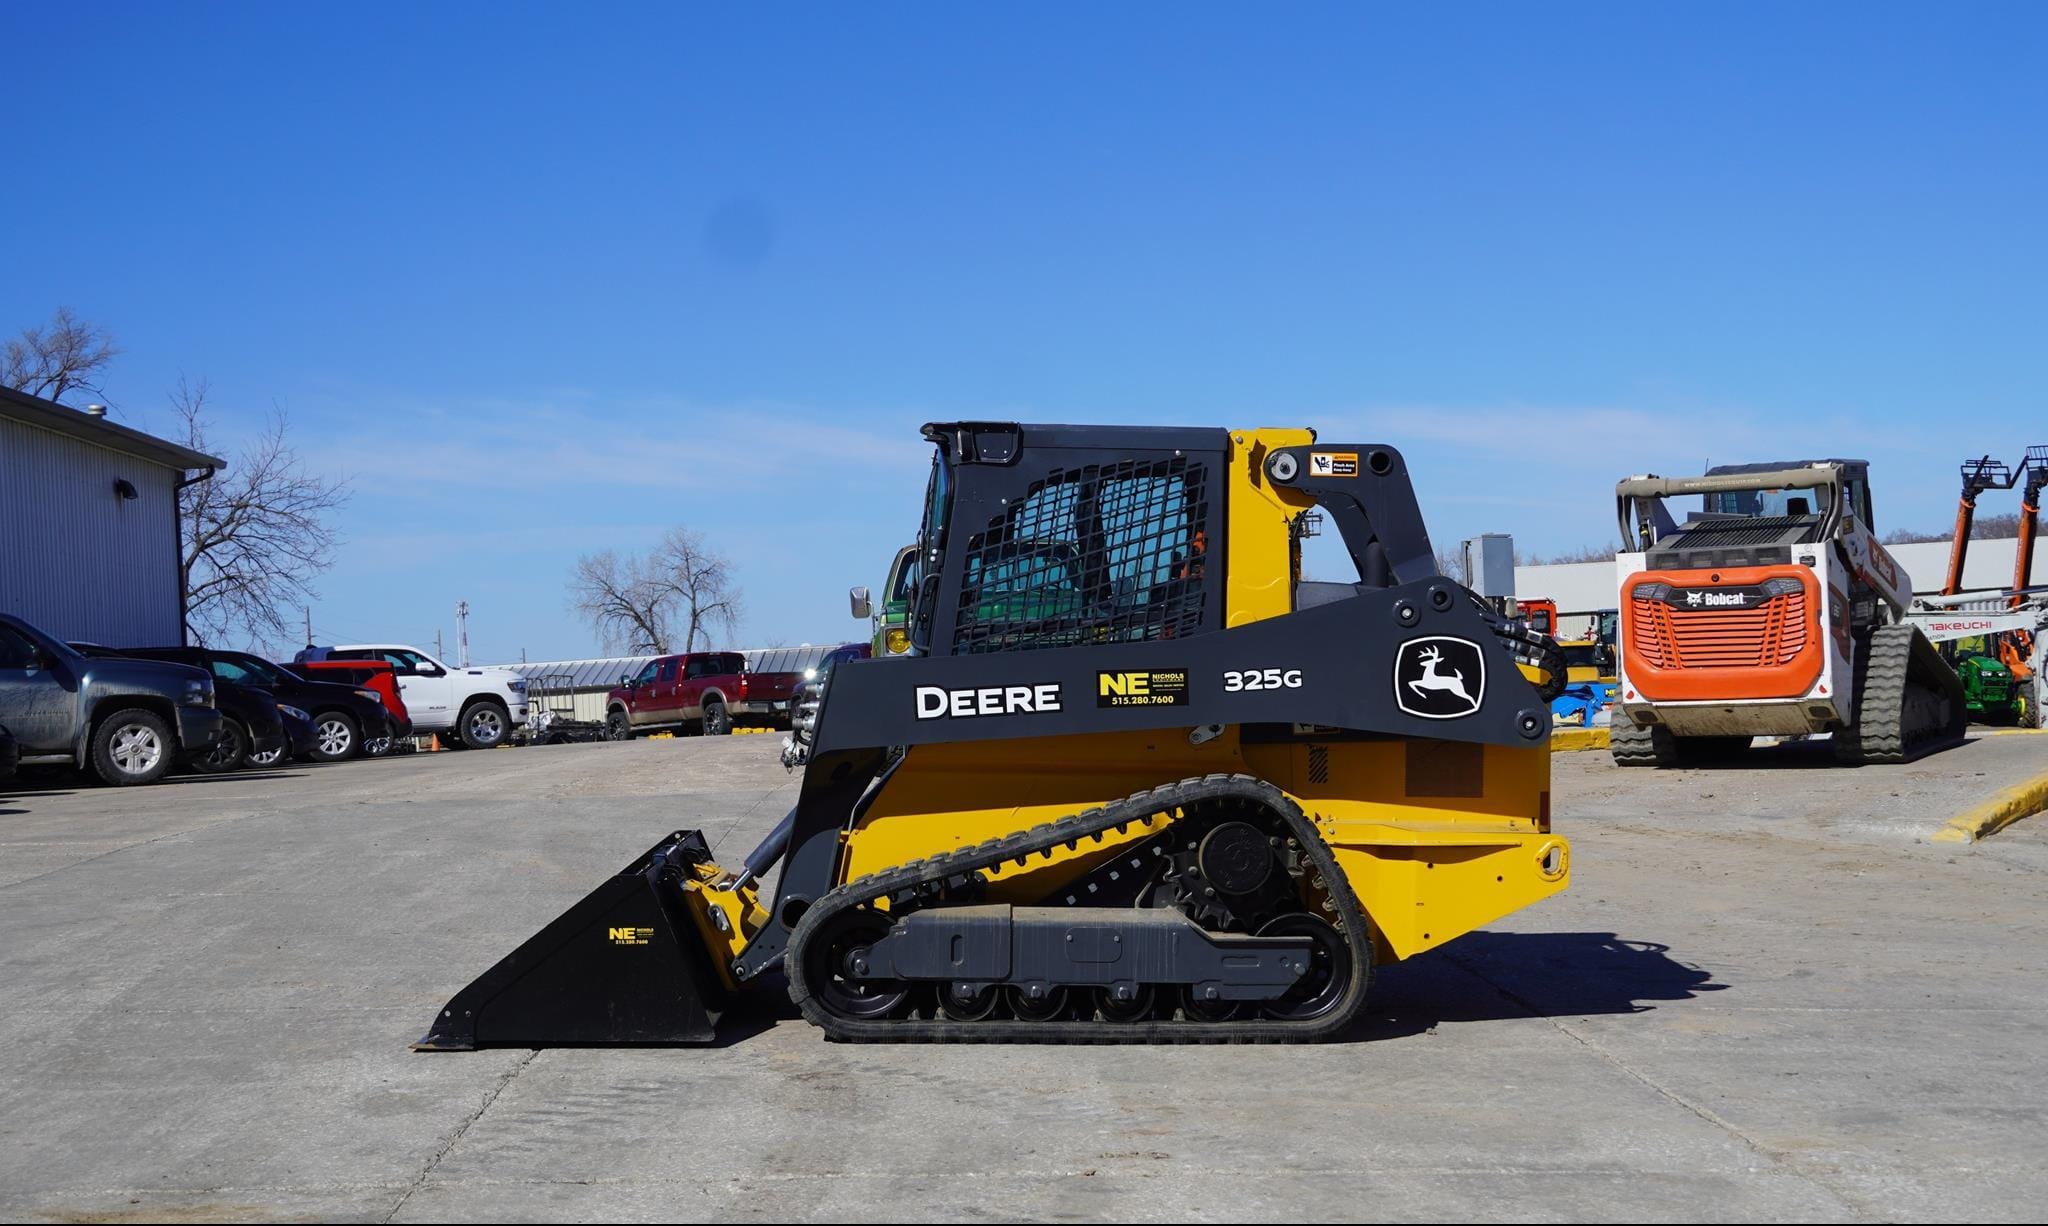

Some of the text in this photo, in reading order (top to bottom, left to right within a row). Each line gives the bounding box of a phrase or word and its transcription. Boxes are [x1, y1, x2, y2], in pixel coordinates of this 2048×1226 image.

[1705, 592, 1744, 606] Bobcat
[1928, 621, 1992, 631] TAKEUCHI
[1099, 672, 1150, 696] NE
[1224, 668, 1302, 692] 325G
[916, 684, 1061, 719] DEERE
[1112, 695, 1174, 705] 515.280.7600
[609, 927, 636, 940] NE
